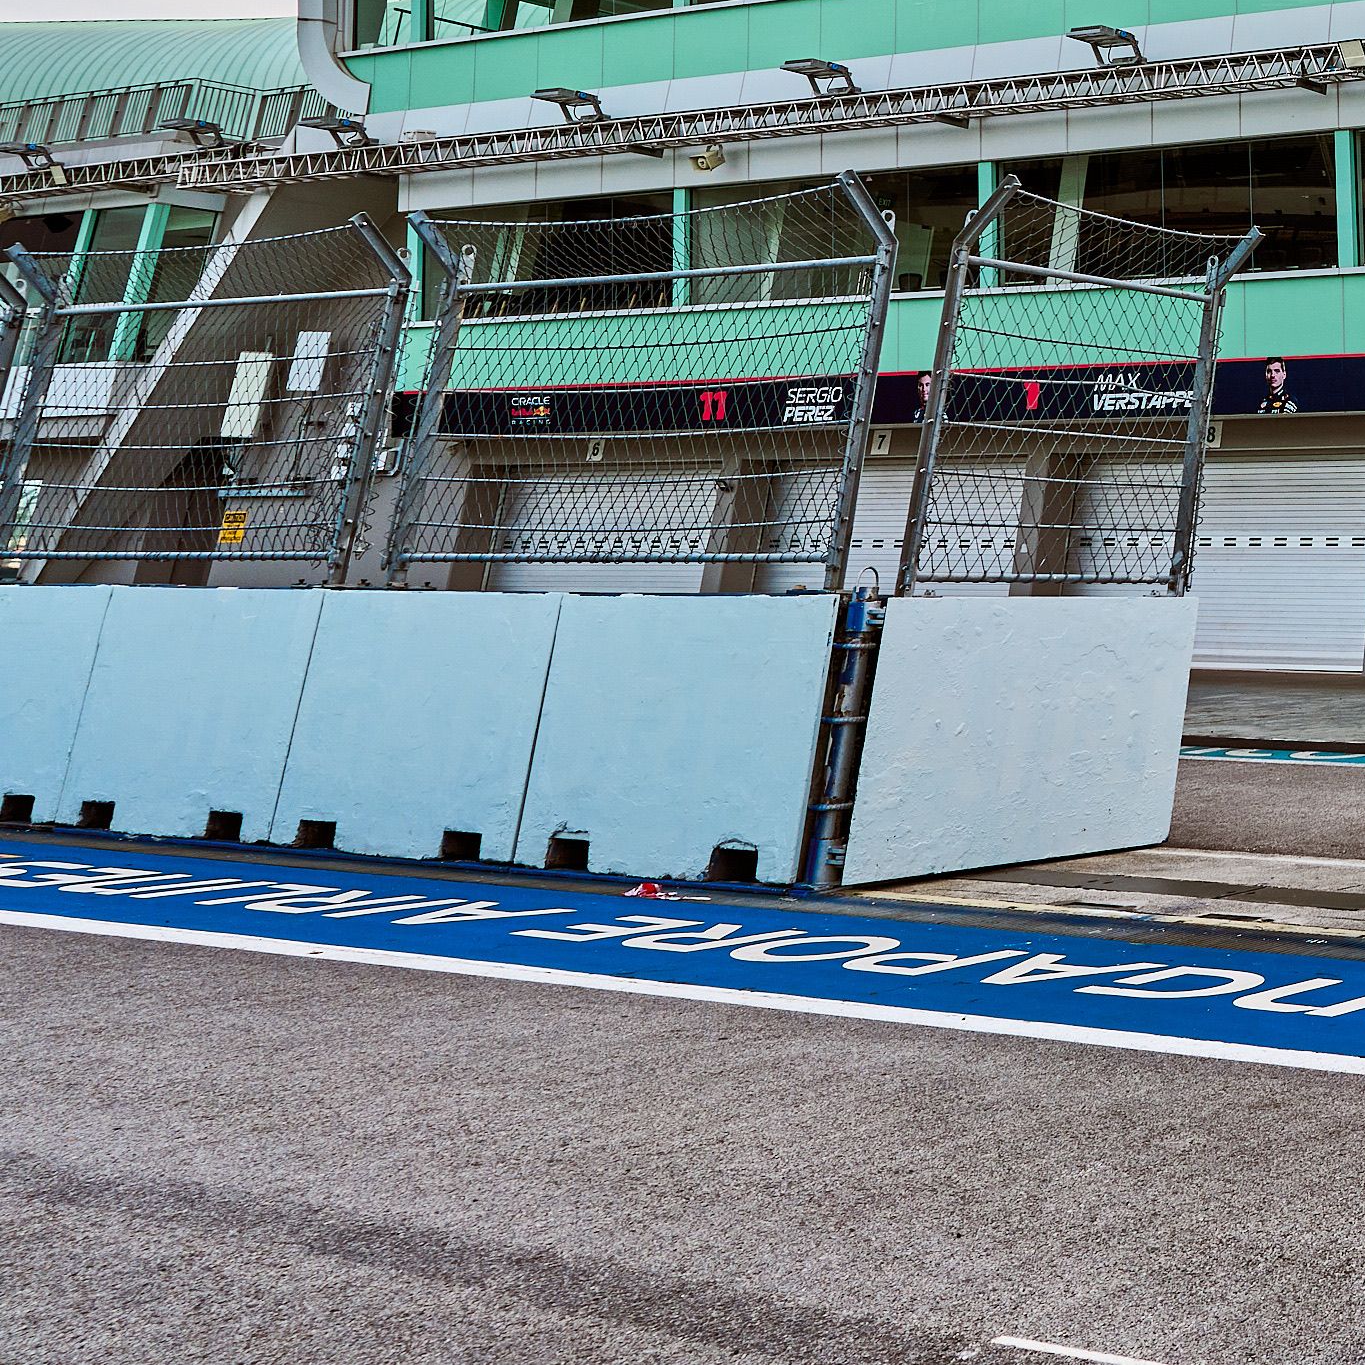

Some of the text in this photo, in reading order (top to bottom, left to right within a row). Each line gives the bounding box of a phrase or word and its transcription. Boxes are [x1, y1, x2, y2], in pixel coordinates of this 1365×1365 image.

[1093, 373, 1141, 391] MAX
[511, 396, 551, 406] ORACLE
[786, 386, 843, 404] SERGIO
[1093, 390, 1208, 411] VERSTAPPE
[700, 391, 727, 421] 11
[783, 405, 836, 422] PEREZ
[877, 434, 886, 450] 7
[1206, 426, 1216, 443] 8
[592, 442, 601, 457] 6
